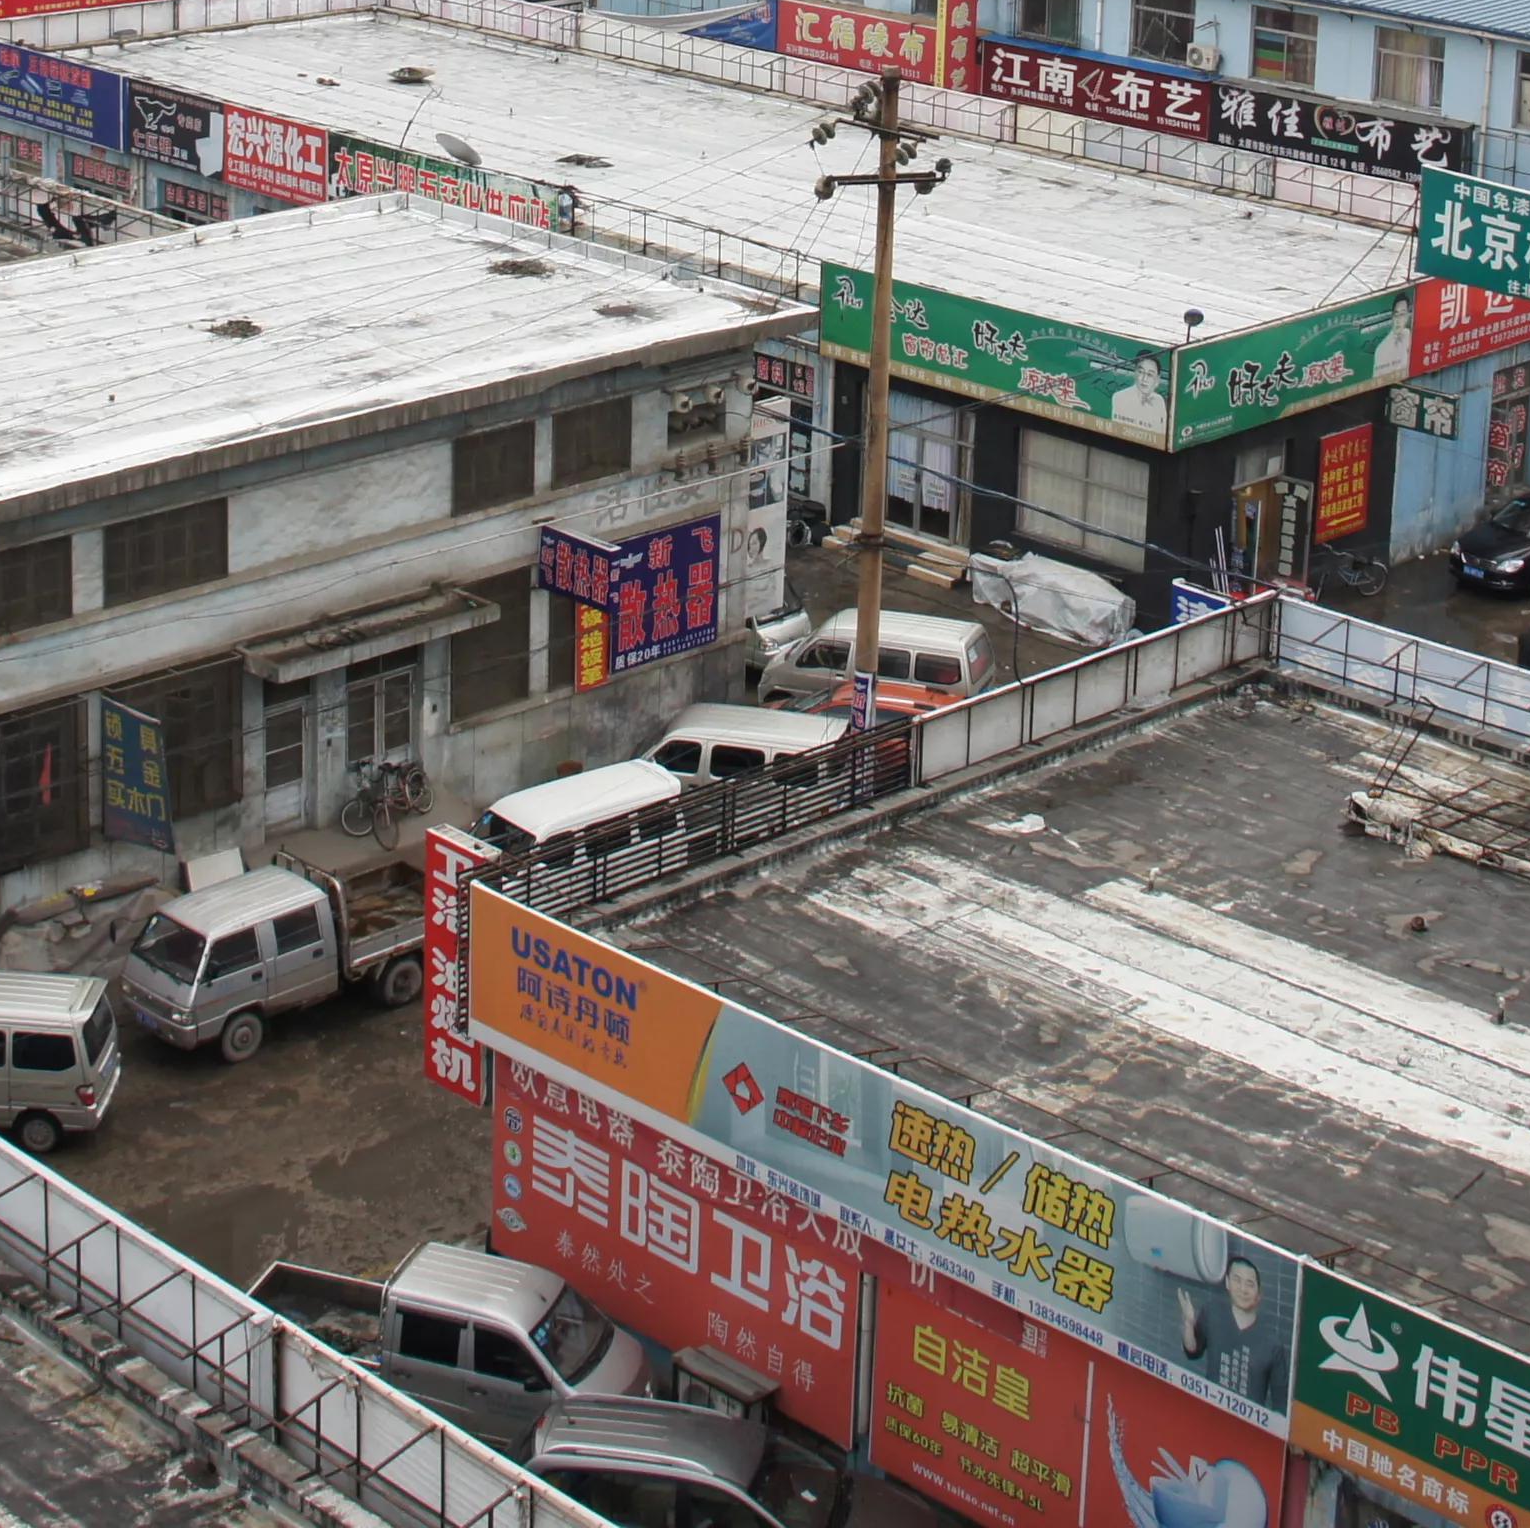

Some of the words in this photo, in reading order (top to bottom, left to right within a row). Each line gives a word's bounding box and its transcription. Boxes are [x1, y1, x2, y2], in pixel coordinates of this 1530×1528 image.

[990, 47, 1075, 94] 江南
[1110, 69, 1205, 123] 布艺
[227, 110, 324, 177] 宏兴源化工
[1218, 83, 1305, 141] 雅佳
[1354, 115, 1453, 168] 布艺
[971, 319, 1030, 366] 好丈夫
[1227, 350, 1301, 408] 好丈夫
[1389, 387, 1457, 436] 窗帘
[554, 538, 611, 606] 散热器
[648, 526, 715, 571] 新飞
[618, 559, 715, 653] 散热器
[614, 643, 661, 672] 质保20年
[104, 710, 159, 751] 锁具
[105, 747, 163, 789] 五金
[106, 779, 167, 822] 实木门
[510, 925, 639, 1012] USATON
[516, 965, 631, 1048] 阿诗丹顿
[888, 1099, 978, 1186] 速热
[1022, 1162, 1117, 1250] 储热
[531, 1115, 847, 1352] 泰陶卫浴
[554, 1228, 657, 1306] 泰然处之
[883, 1168, 1117, 1314] 电热水器
[767, 1162, 822, 1209] 东兴装饰城
[928, 1252, 977, 1285] 2663340
[990, 1279, 1022, 1311] 手机:
[1027, 1299, 1106, 1347] 13834598448
[1117, 1339, 1175, 1384] 售后电话:
[1180, 1373, 1271, 1429] 0351-7120712
[707, 1310, 817, 1394] 陶然自得
[912, 1324, 1031, 1422] 自洁皇
[884, 1415, 944, 1457] 质保60年
[885, 1381, 925, 1419] 抗菌
[940, 1411, 1000, 1460] 易清洁
[1010, 1448, 1073, 1498] 超平滑
[1322, 1428, 1471, 1516] 中国驰名商标
[1344, 1391, 1401, 1437] PB
[1433, 1432, 1519, 1496] PPR
[911, 1460, 1017, 1528] www.taitao.net.cn
